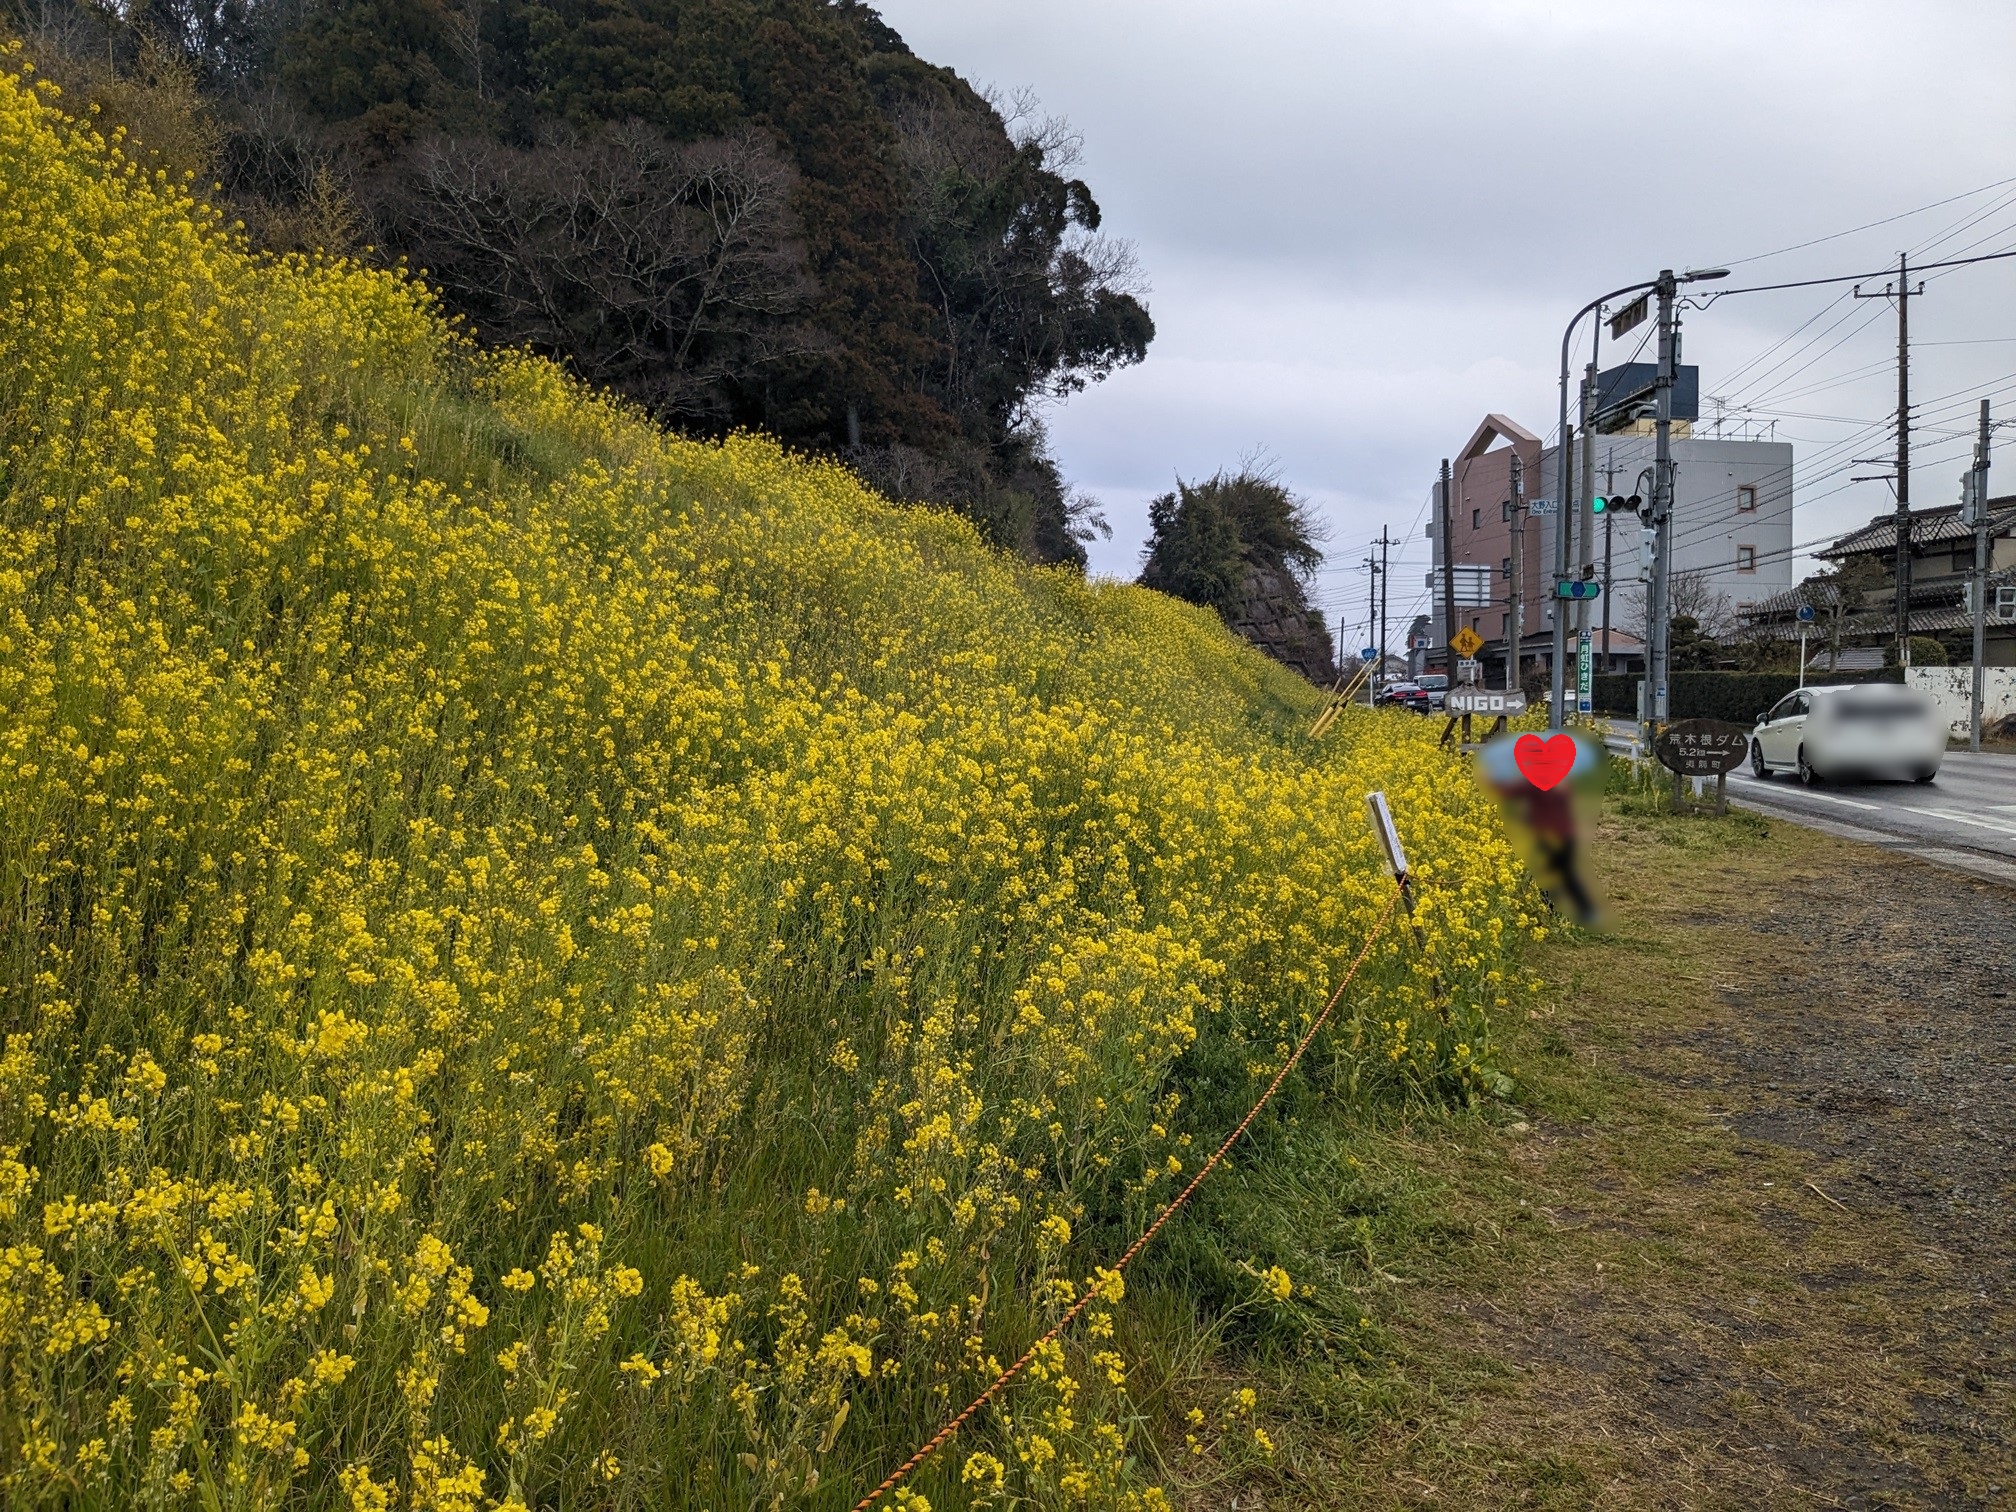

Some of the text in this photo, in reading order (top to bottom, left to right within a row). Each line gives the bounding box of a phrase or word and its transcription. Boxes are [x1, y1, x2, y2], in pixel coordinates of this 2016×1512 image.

[1451, 696, 1504, 711] NIGO
[1669, 733, 1744, 746] 荒木根ダム
